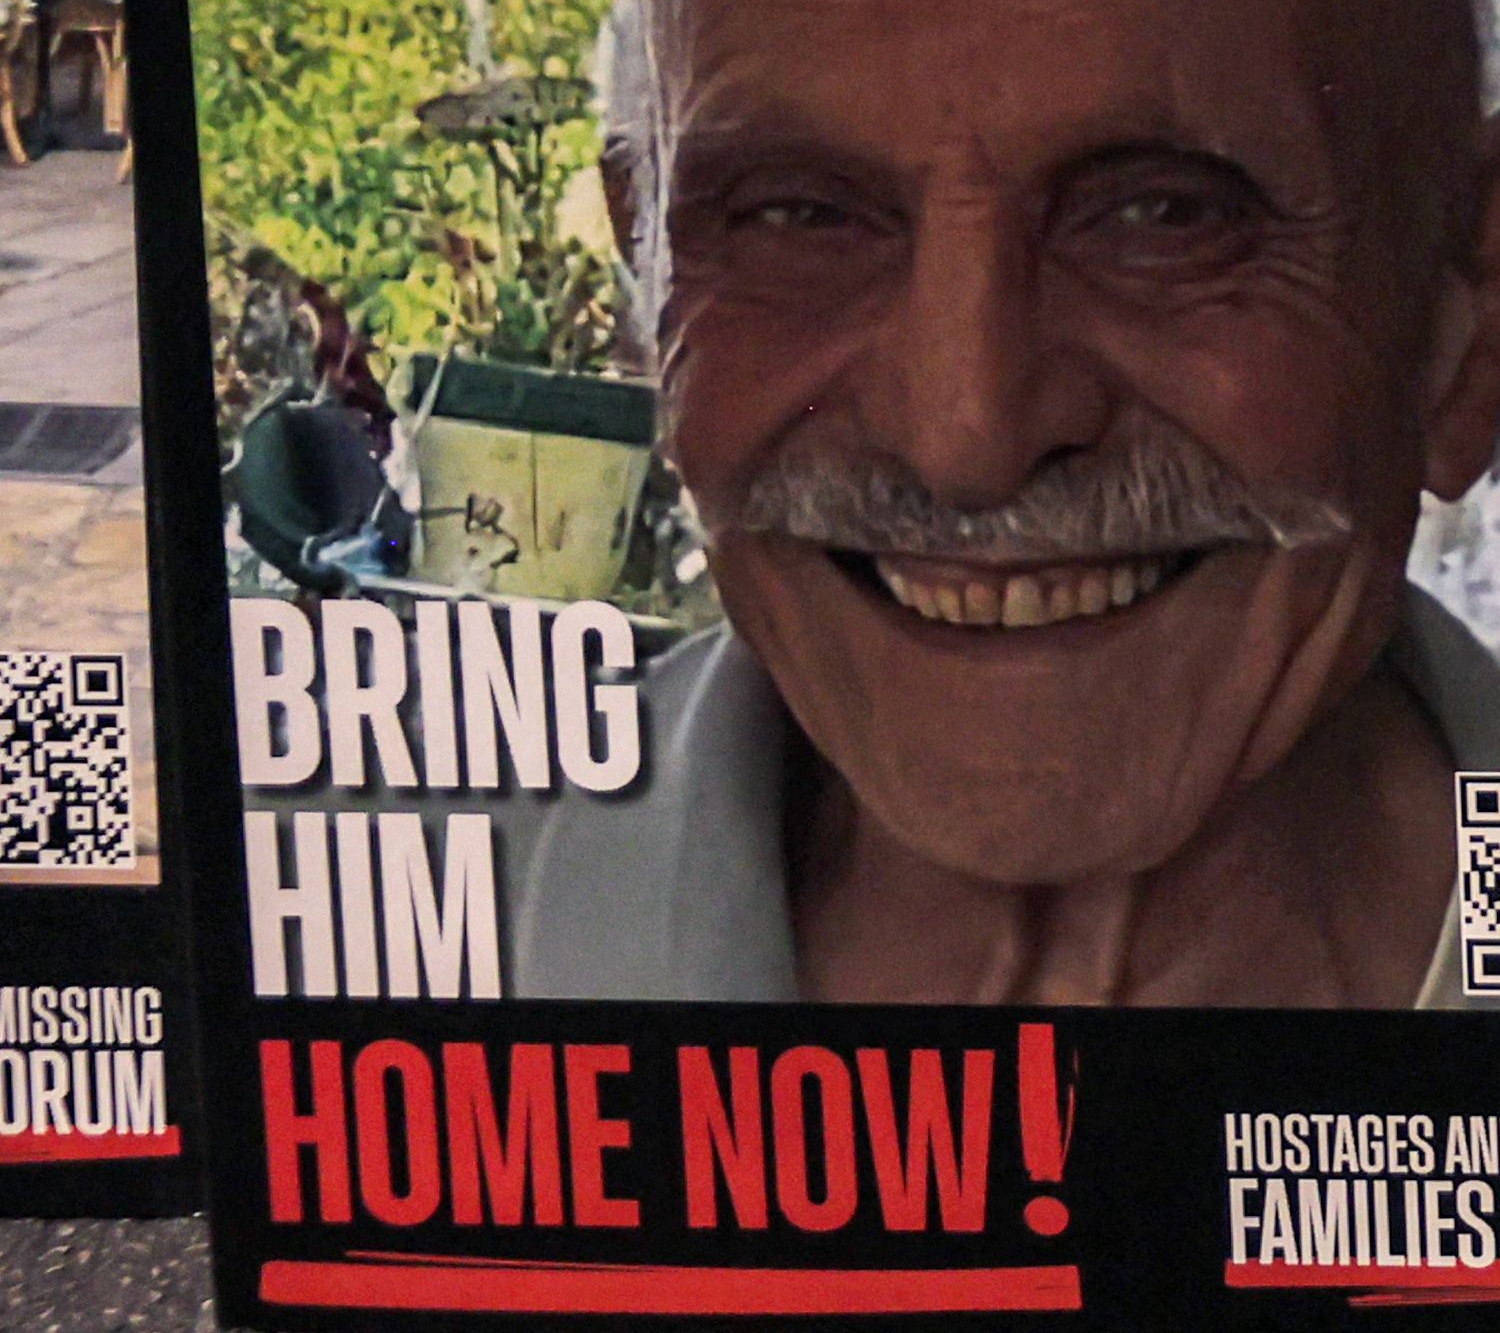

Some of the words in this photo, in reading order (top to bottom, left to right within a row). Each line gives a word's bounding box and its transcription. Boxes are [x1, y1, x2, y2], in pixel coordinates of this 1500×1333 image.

[229, 597, 641, 793] BRING
[243, 809, 502, 1000] HIM
[0, 1049, 168, 1137] ORUM
[258, 1038, 641, 1228] HOME
[676, 1022, 1079, 1237] NOW!
[1224, 1111, 1435, 1175] HOSTAGES
[1229, 1177, 1496, 1265] FAMILIES
